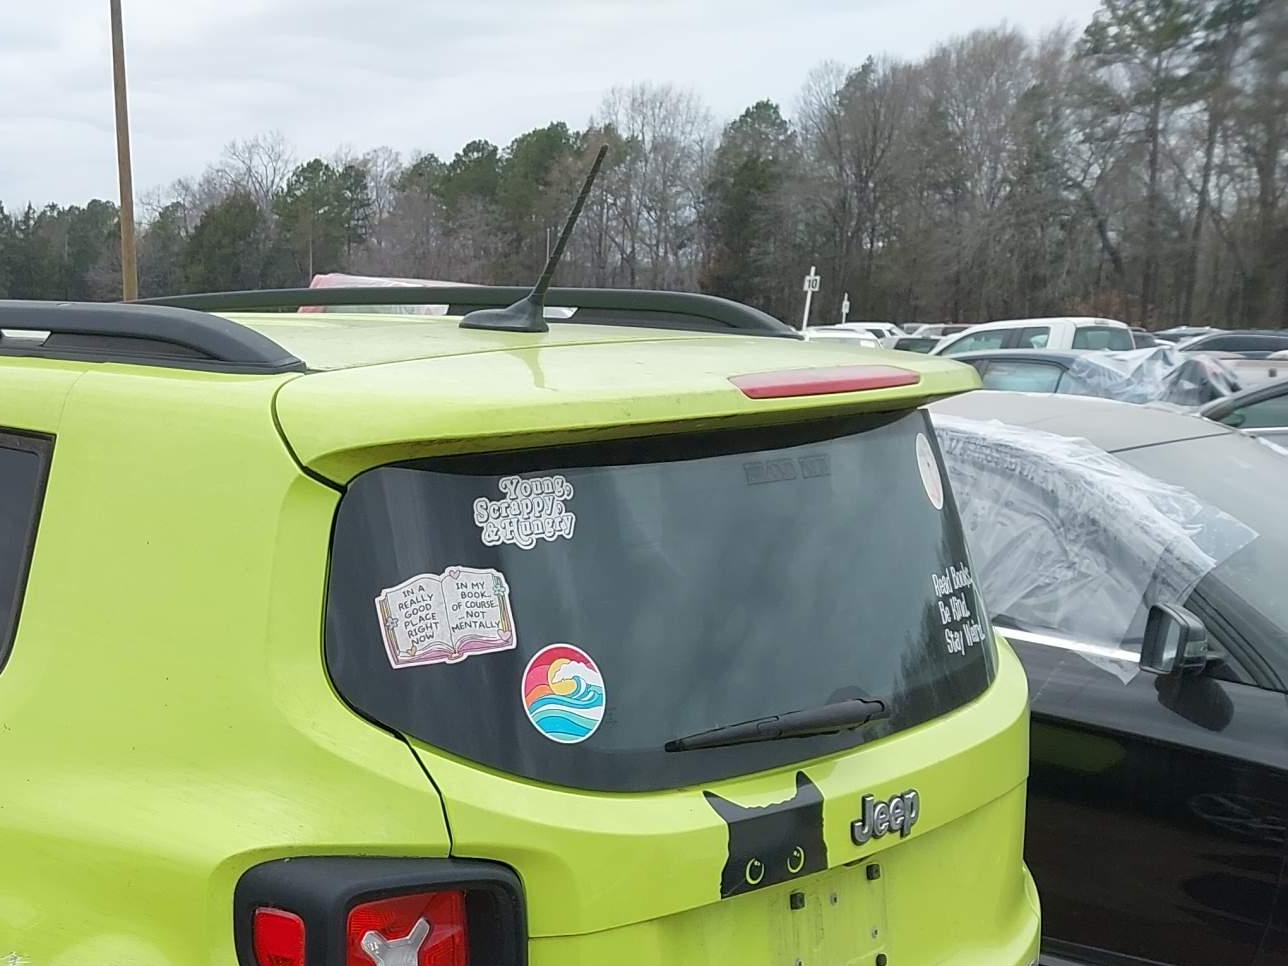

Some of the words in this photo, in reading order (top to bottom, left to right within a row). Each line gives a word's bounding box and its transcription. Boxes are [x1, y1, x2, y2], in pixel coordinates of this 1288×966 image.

[808, 279, 818, 289] 10
[501, 478, 572, 500] Young,
[475, 495, 564, 523] Scrappy,
[483, 521, 500, 542] &
[501, 515, 574, 547] Hungry
[456, 582, 468, 590] IN
[472, 581, 485, 590] MY
[932, 567, 953, 597] Read
[398, 593, 434, 611] REALLY
[402, 589, 414, 598] IN
[404, 603, 432, 619] GOOD
[452, 602, 463, 611] OF
[938, 601, 951, 624] Be
[950, 592, 970, 621] Kind.
[404, 612, 436, 630] PLACE
[408, 621, 439, 638] RIGHT
[452, 620, 500, 632] MENTALLY
[412, 631, 434, 647] NOW
[945, 628, 965, 655] Stay
[851, 789, 920, 846] Jeep
